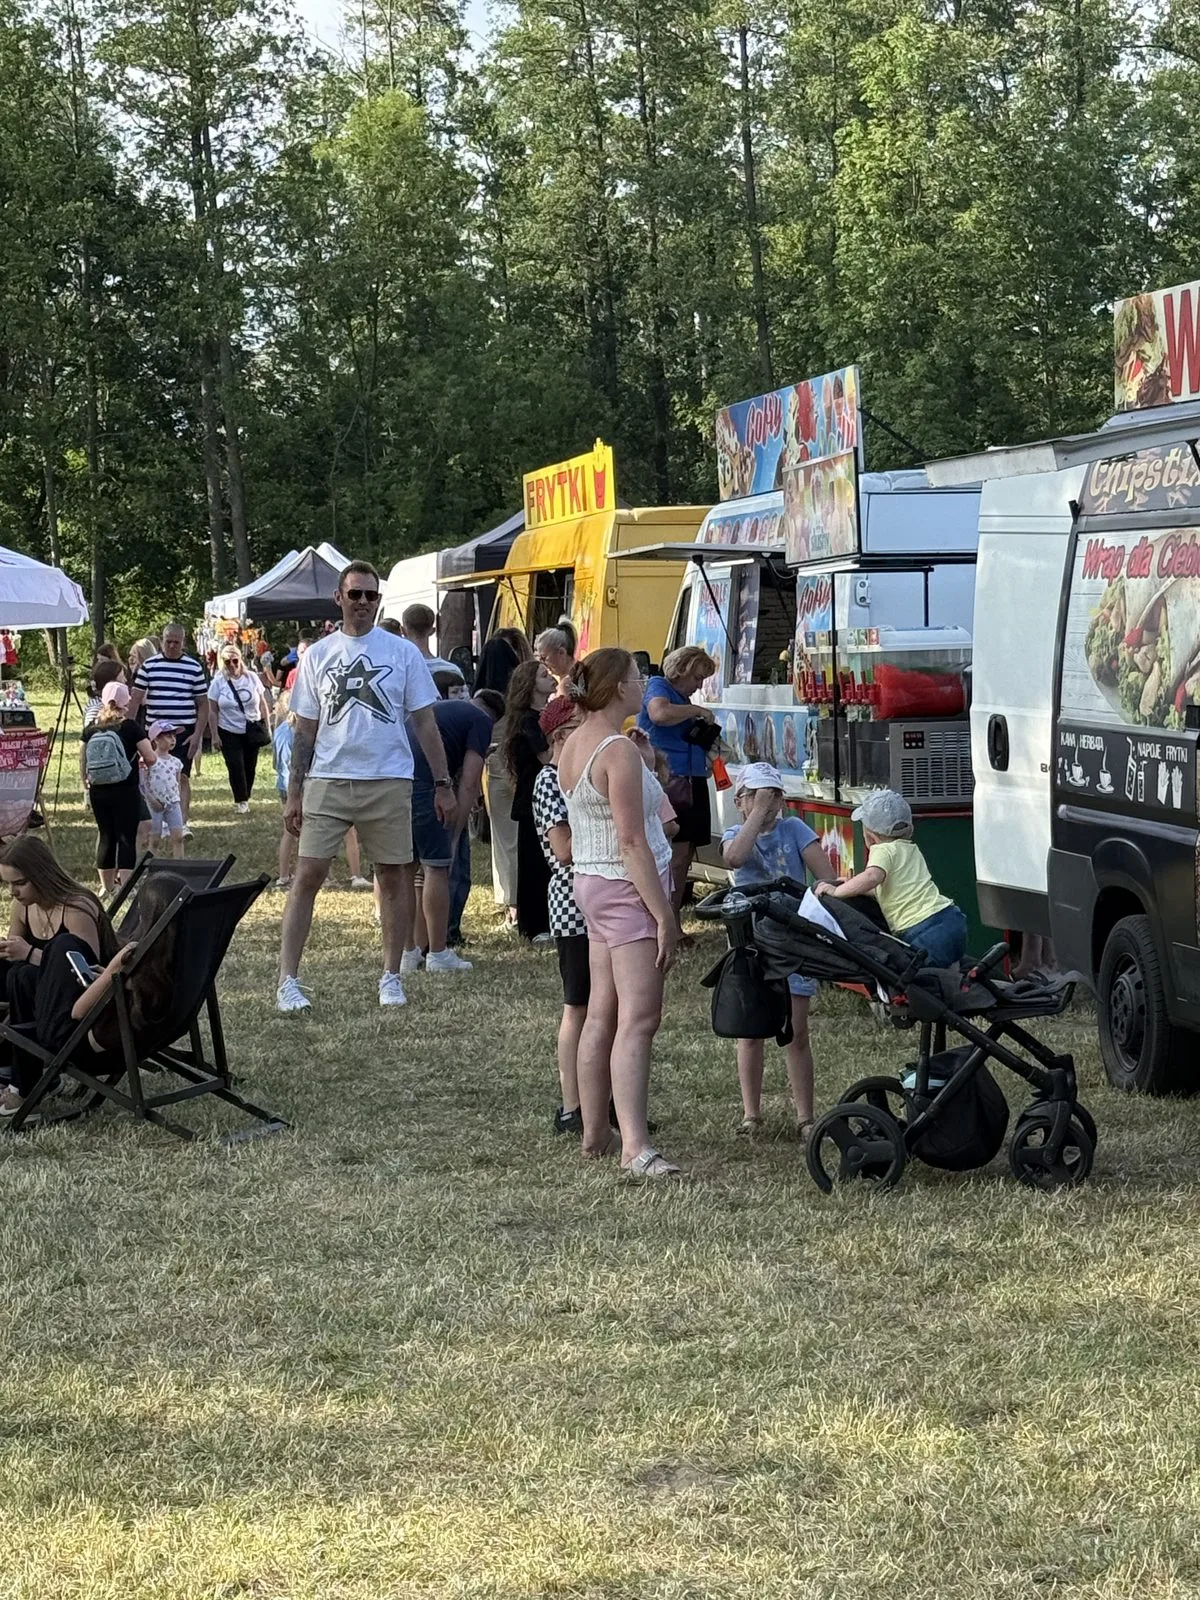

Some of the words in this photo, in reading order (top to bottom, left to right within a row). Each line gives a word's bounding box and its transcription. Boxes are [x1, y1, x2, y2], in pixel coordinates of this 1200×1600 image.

[1163, 286, 1200, 397] W
[526, 465, 588, 525] FRYTKI
[1082, 538, 1126, 587] Wrap
[1126, 535, 1154, 579] dla
[1060, 732, 1076, 747] KAWA
[1079, 734, 1104, 751] HERBATA
[1137, 741, 1162, 760] NAPOJE
[1165, 745, 1188, 763] FRYTKI
